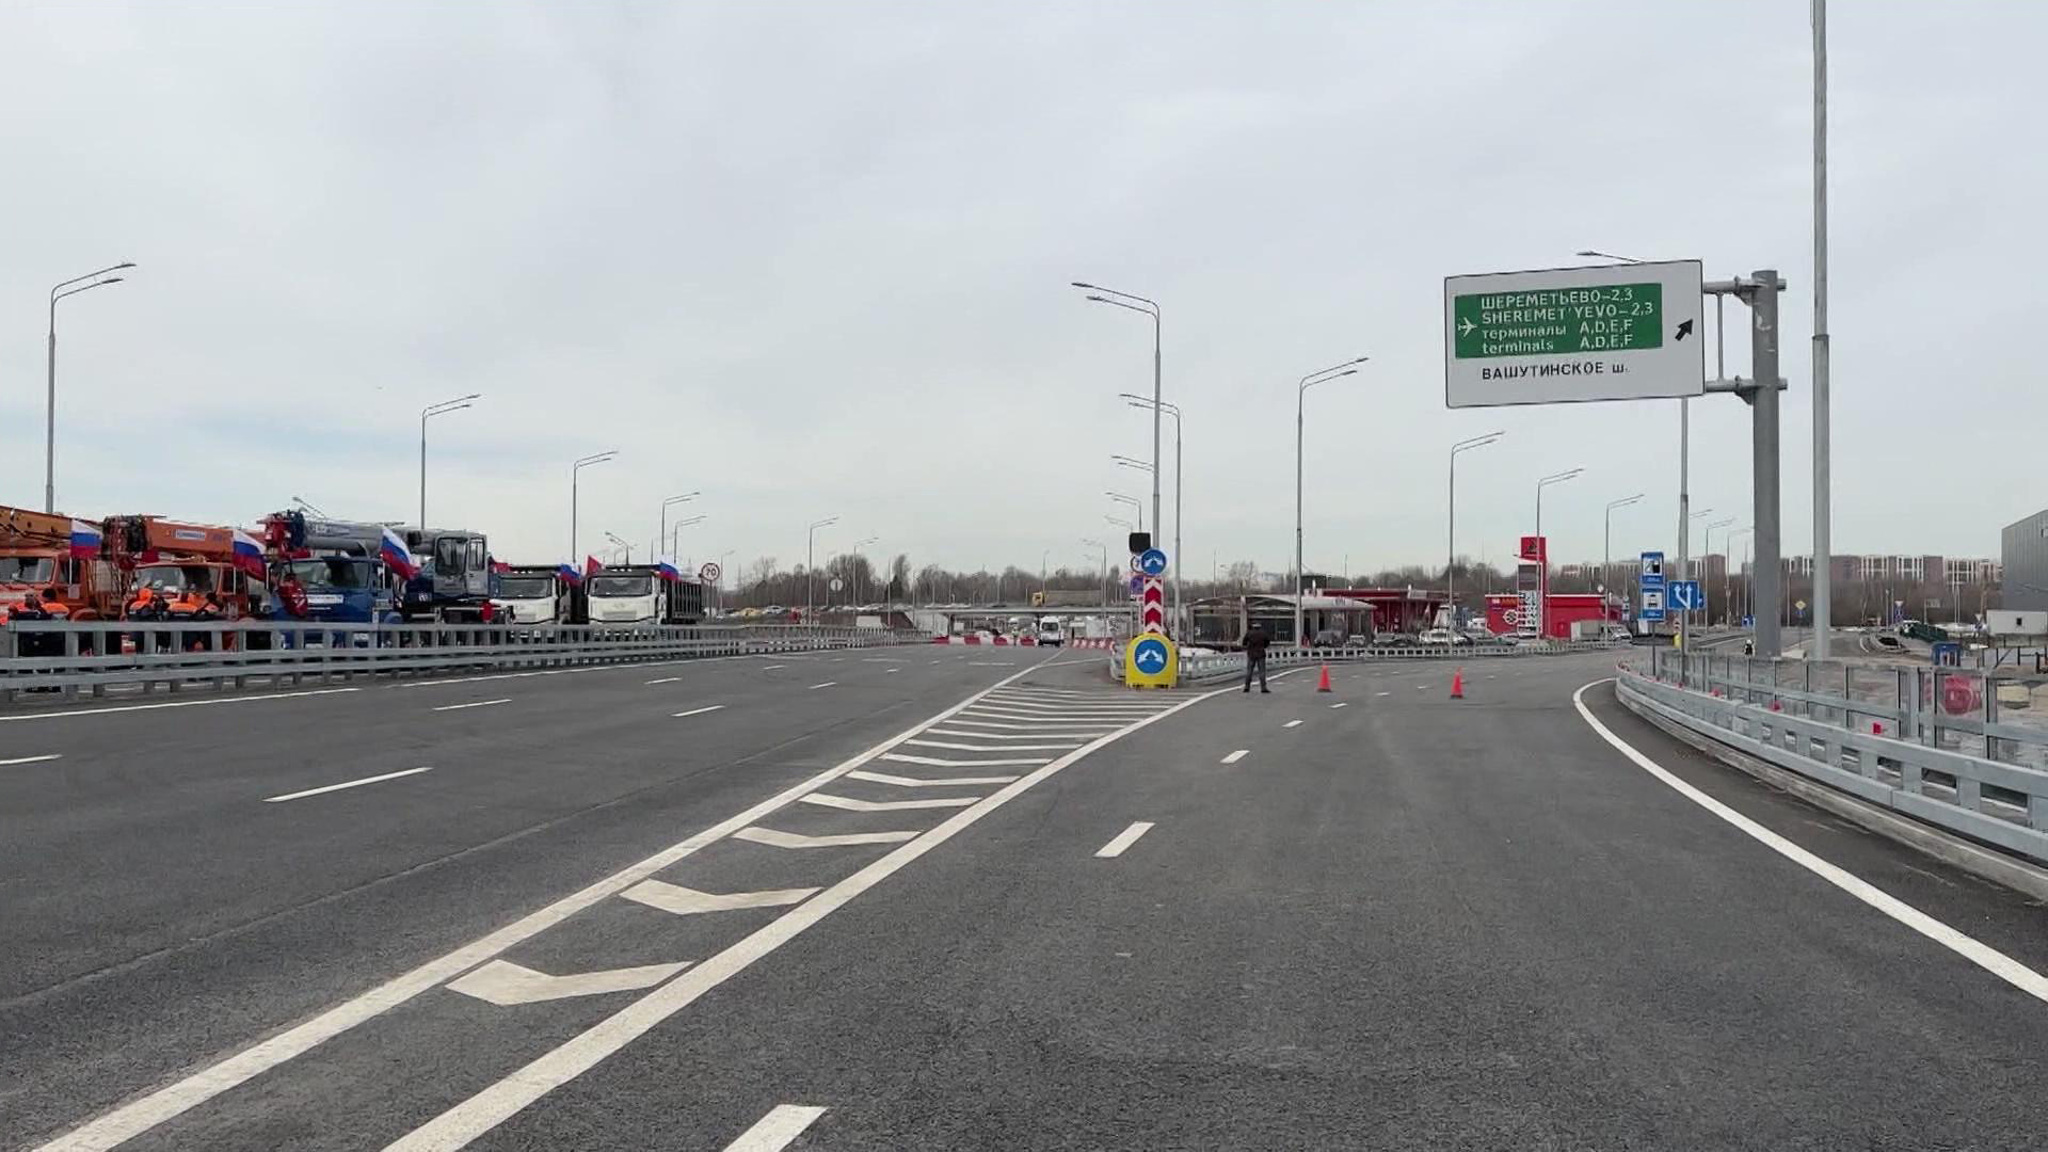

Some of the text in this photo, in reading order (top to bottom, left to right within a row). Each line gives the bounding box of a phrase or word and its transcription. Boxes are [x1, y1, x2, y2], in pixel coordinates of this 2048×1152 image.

[1482, 324, 1566, 341] терминалы
[1483, 341, 1554, 355] terminals
[1482, 361, 1629, 380] ВАШУТИНСКОЕ ш.
